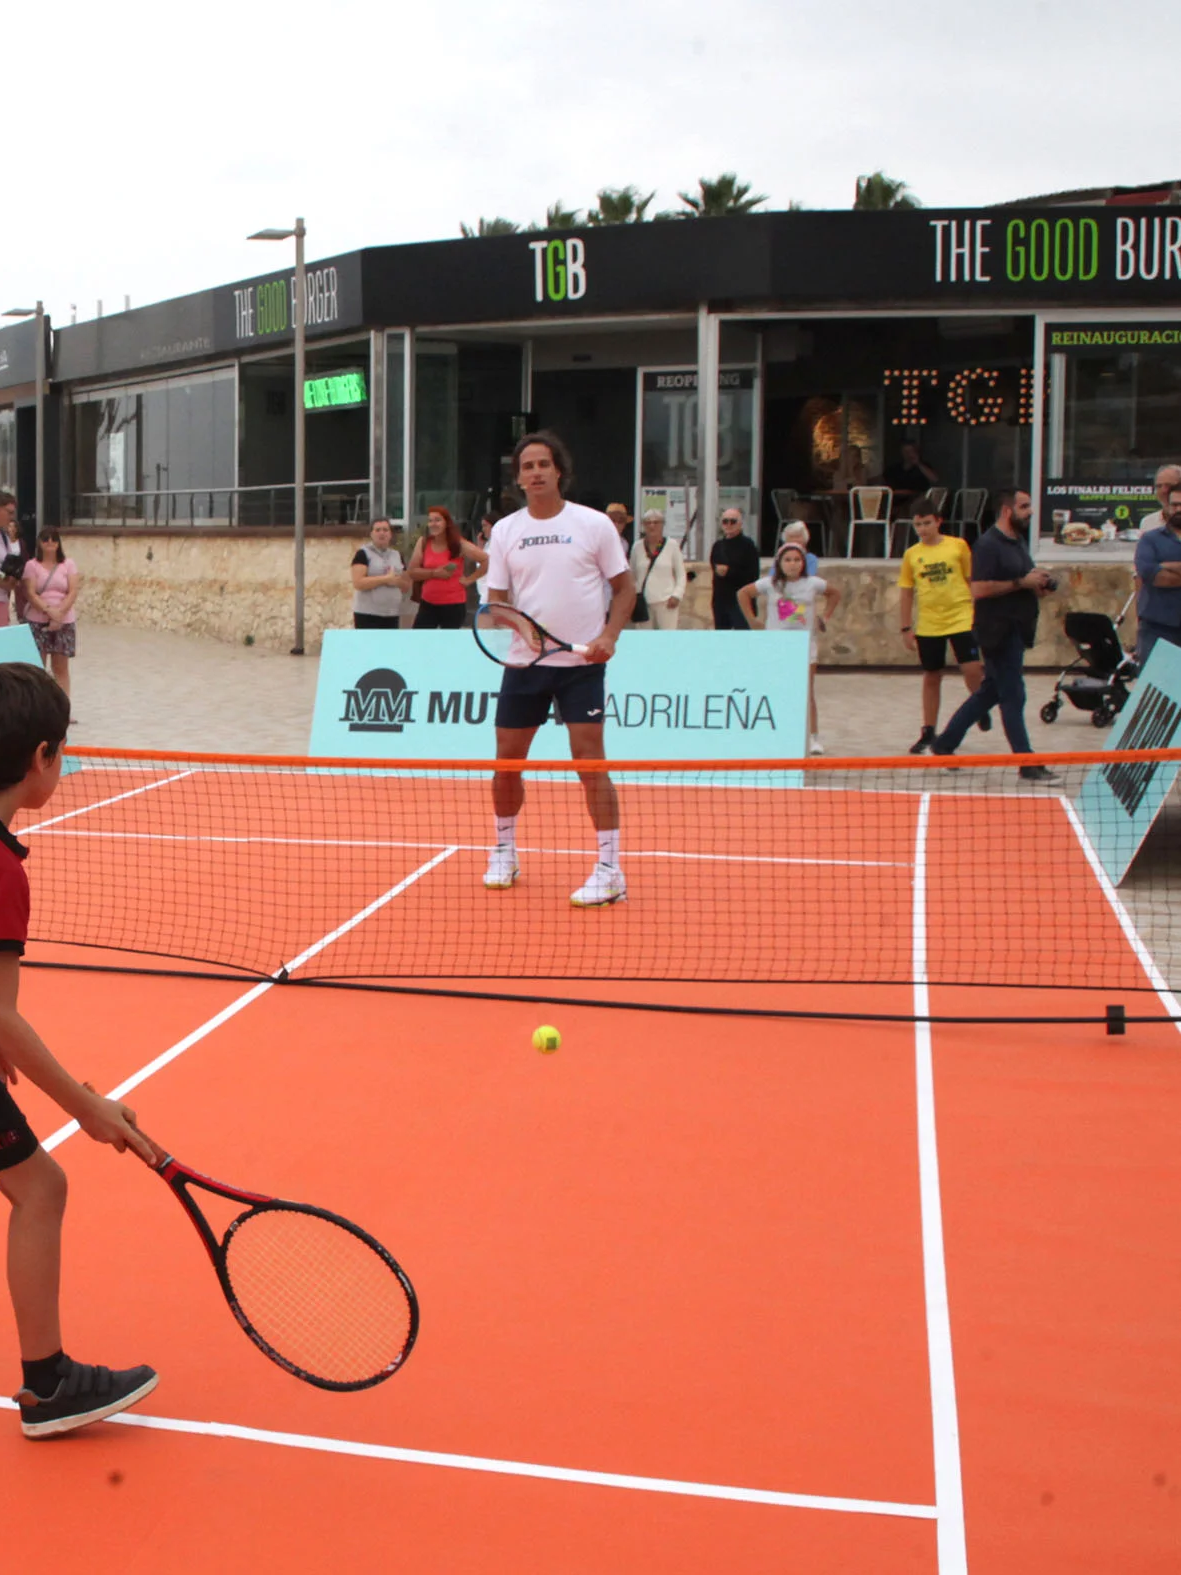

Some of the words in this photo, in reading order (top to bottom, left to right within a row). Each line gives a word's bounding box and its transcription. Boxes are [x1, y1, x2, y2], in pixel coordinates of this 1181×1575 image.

[528, 238, 587, 303] TGB
[929, 219, 992, 282] THE
[1006, 218, 1099, 282] GOOD
[233, 286, 255, 339] THE
[256, 279, 288, 335] GOOD
[1051, 330, 1181, 345] REINAUGURACI
[1047, 486, 1066, 495] LOS
[1068, 486, 1110, 495] FINALES
[1112, 485, 1153, 495] FELICES
[603, 687, 777, 731] ADRILEÑA
